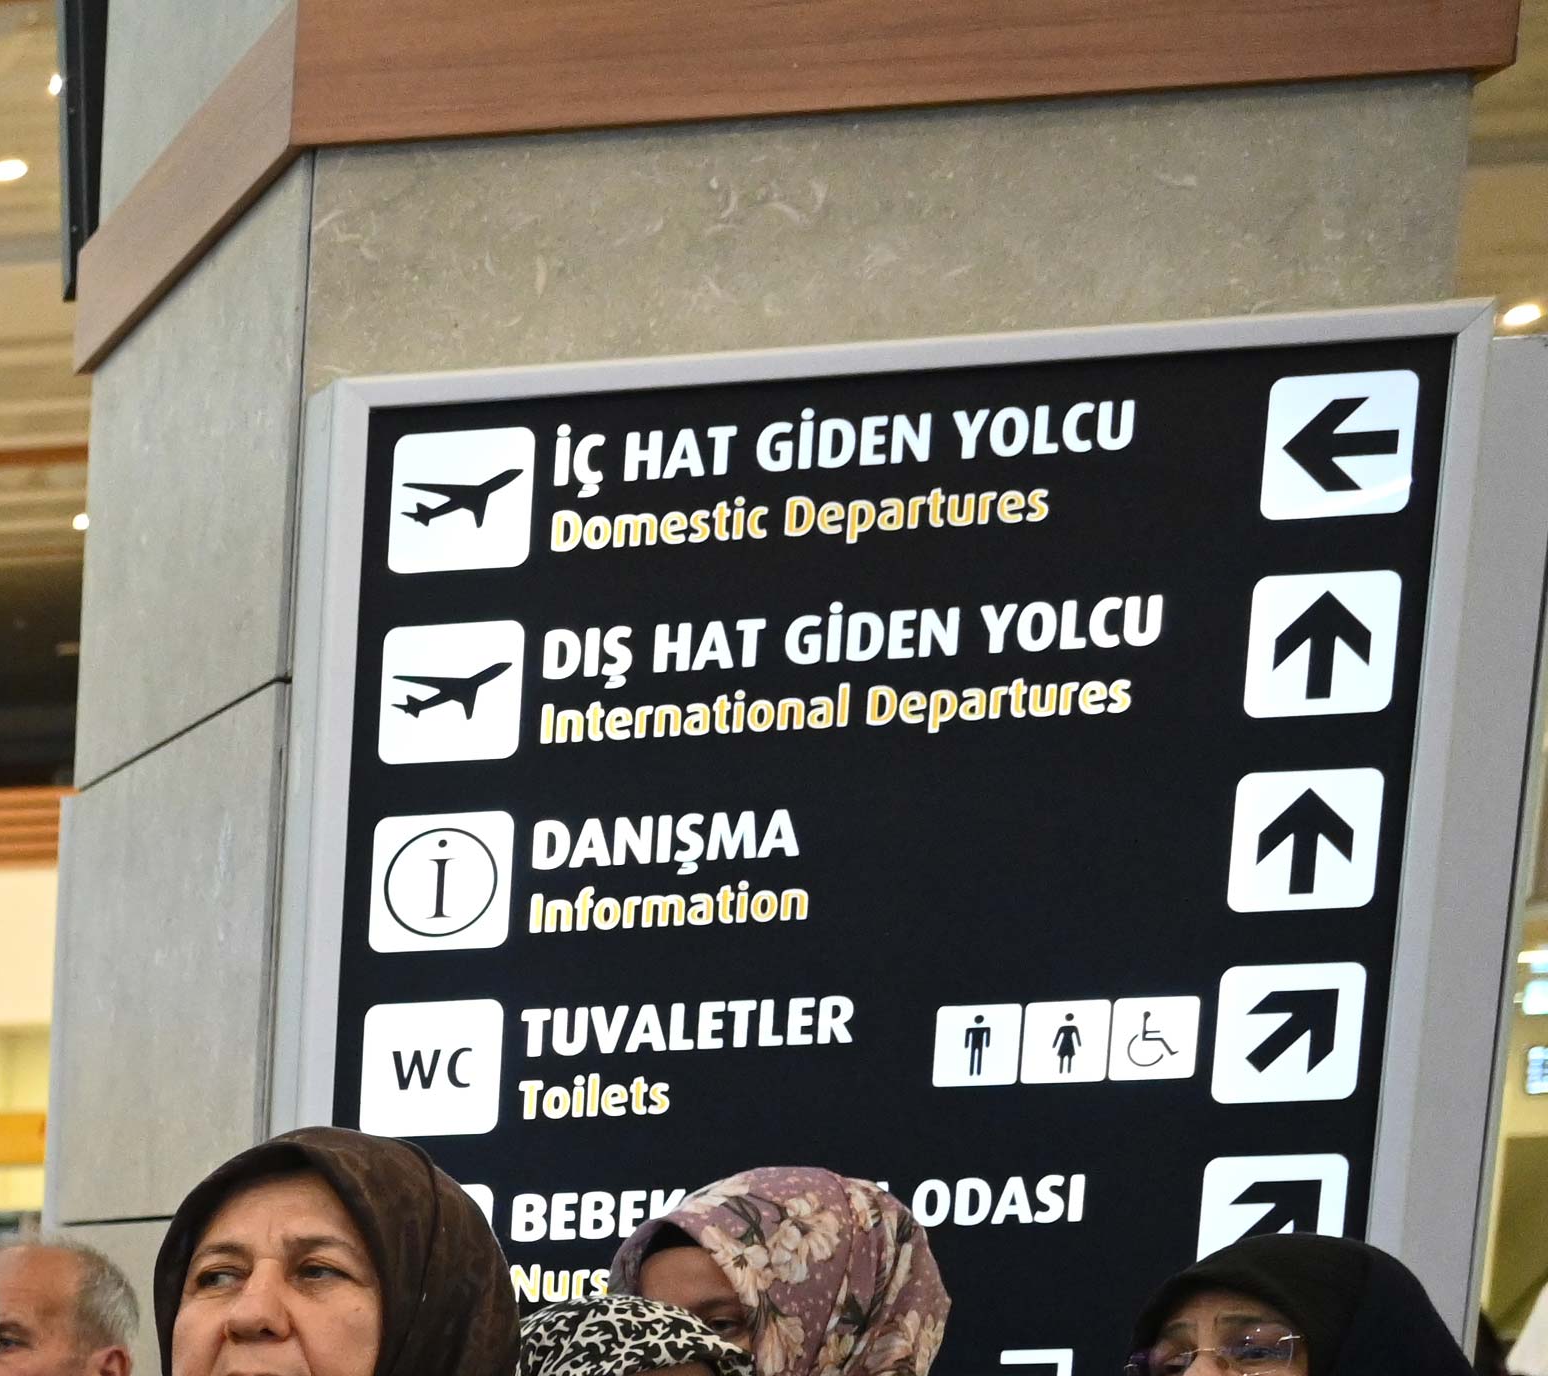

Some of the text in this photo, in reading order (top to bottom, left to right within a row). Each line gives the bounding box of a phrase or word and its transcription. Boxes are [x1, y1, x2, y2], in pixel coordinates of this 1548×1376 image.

[553, 400, 1136, 498] İÇ HAT GİDEN YOLCU
[550, 487, 1050, 552] Domestic Departures
[542, 594, 1164, 689] DIŞ HAT GİDEN YOLCU
[539, 678, 1133, 745] International Departures
[530, 808, 801, 876] DANIŞMA
[528, 880, 810, 934] Information
[520, 995, 855, 1059] TUVALETLER
[392, 1046, 474, 1091] WC
[518, 1073, 671, 1120] Toilets
[510, 1173, 1086, 1242] BEBEK ODASI
[510, 1262, 610, 1303] Nurs
